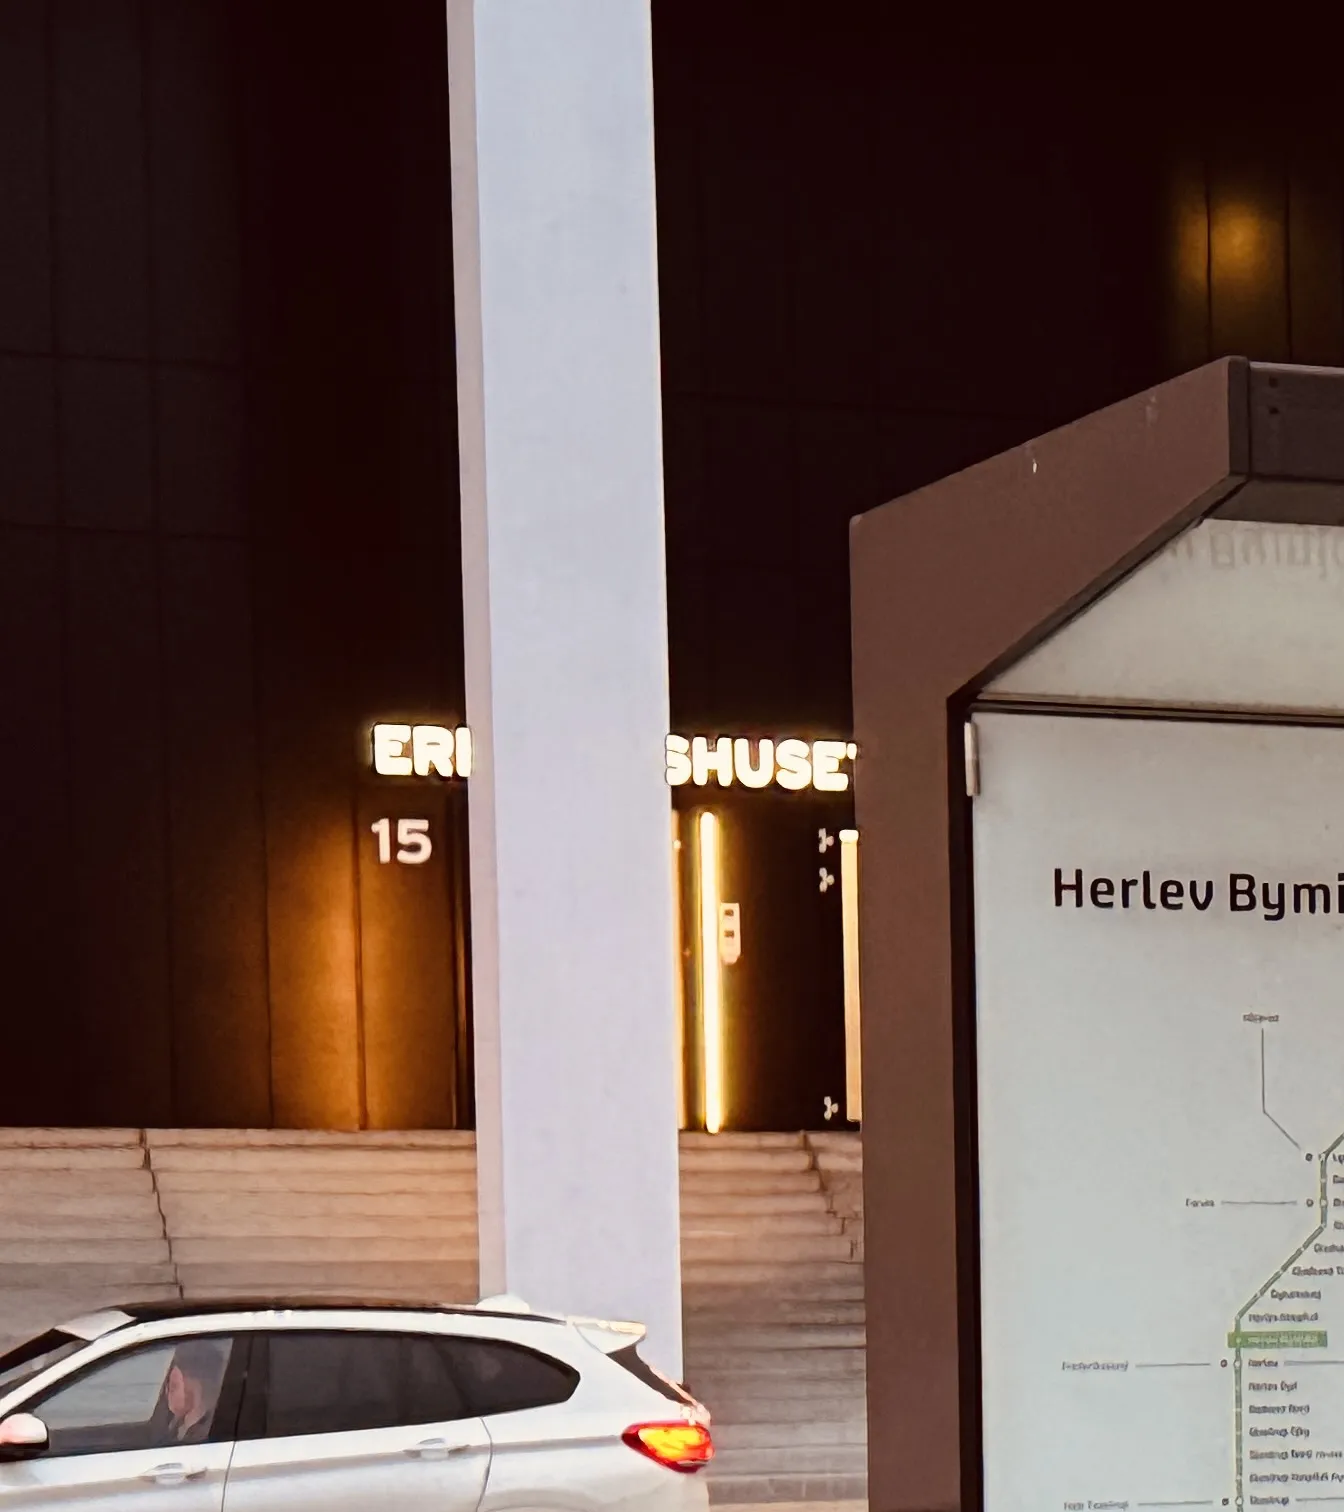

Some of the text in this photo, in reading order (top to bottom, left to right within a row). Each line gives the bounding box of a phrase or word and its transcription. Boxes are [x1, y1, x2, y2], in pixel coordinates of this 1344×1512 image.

[665, 734, 858, 791] SHUSE
[371, 818, 432, 864] 15
[1054, 868, 1214, 911] Herlev
